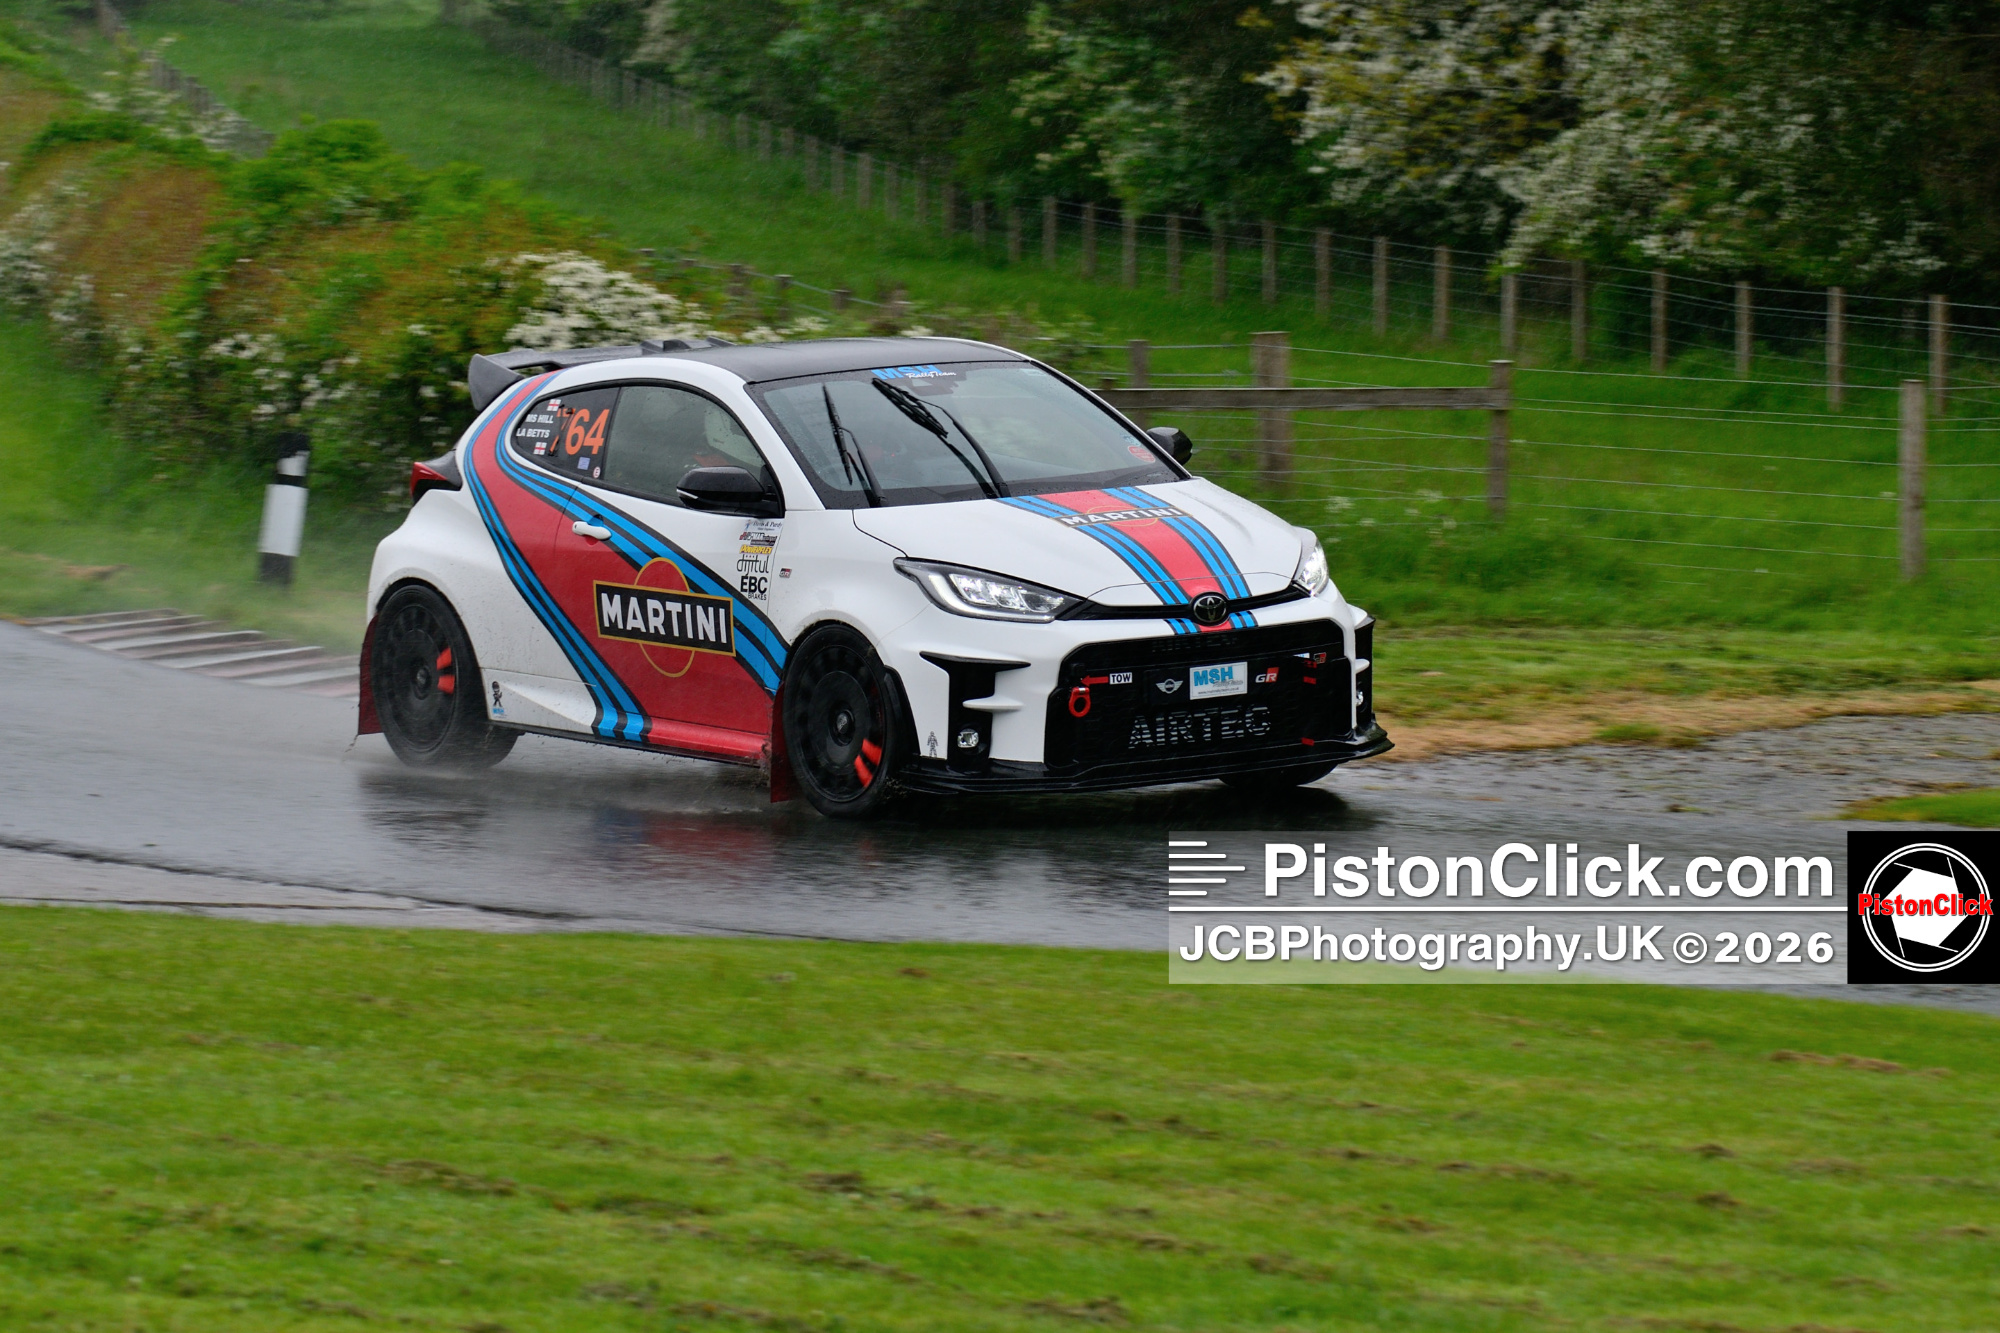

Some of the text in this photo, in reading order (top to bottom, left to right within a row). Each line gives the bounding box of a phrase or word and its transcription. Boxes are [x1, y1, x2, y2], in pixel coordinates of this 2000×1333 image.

[871, 364, 942, 380] MSH
[905, 371, 934, 379] Rally
[537, 414, 554, 424] HILL
[516, 428, 551, 438] LA BETTS
[1061, 508, 1183, 525] MARTINI
[740, 575, 768, 594] EBC
[748, 592, 767, 601] BRAKES
[601, 592, 727, 644] MARTINI
[1111, 673, 1132, 684] TOW
[1193, 666, 1233, 687] MSH
[1255, 672, 1278, 684] GR
